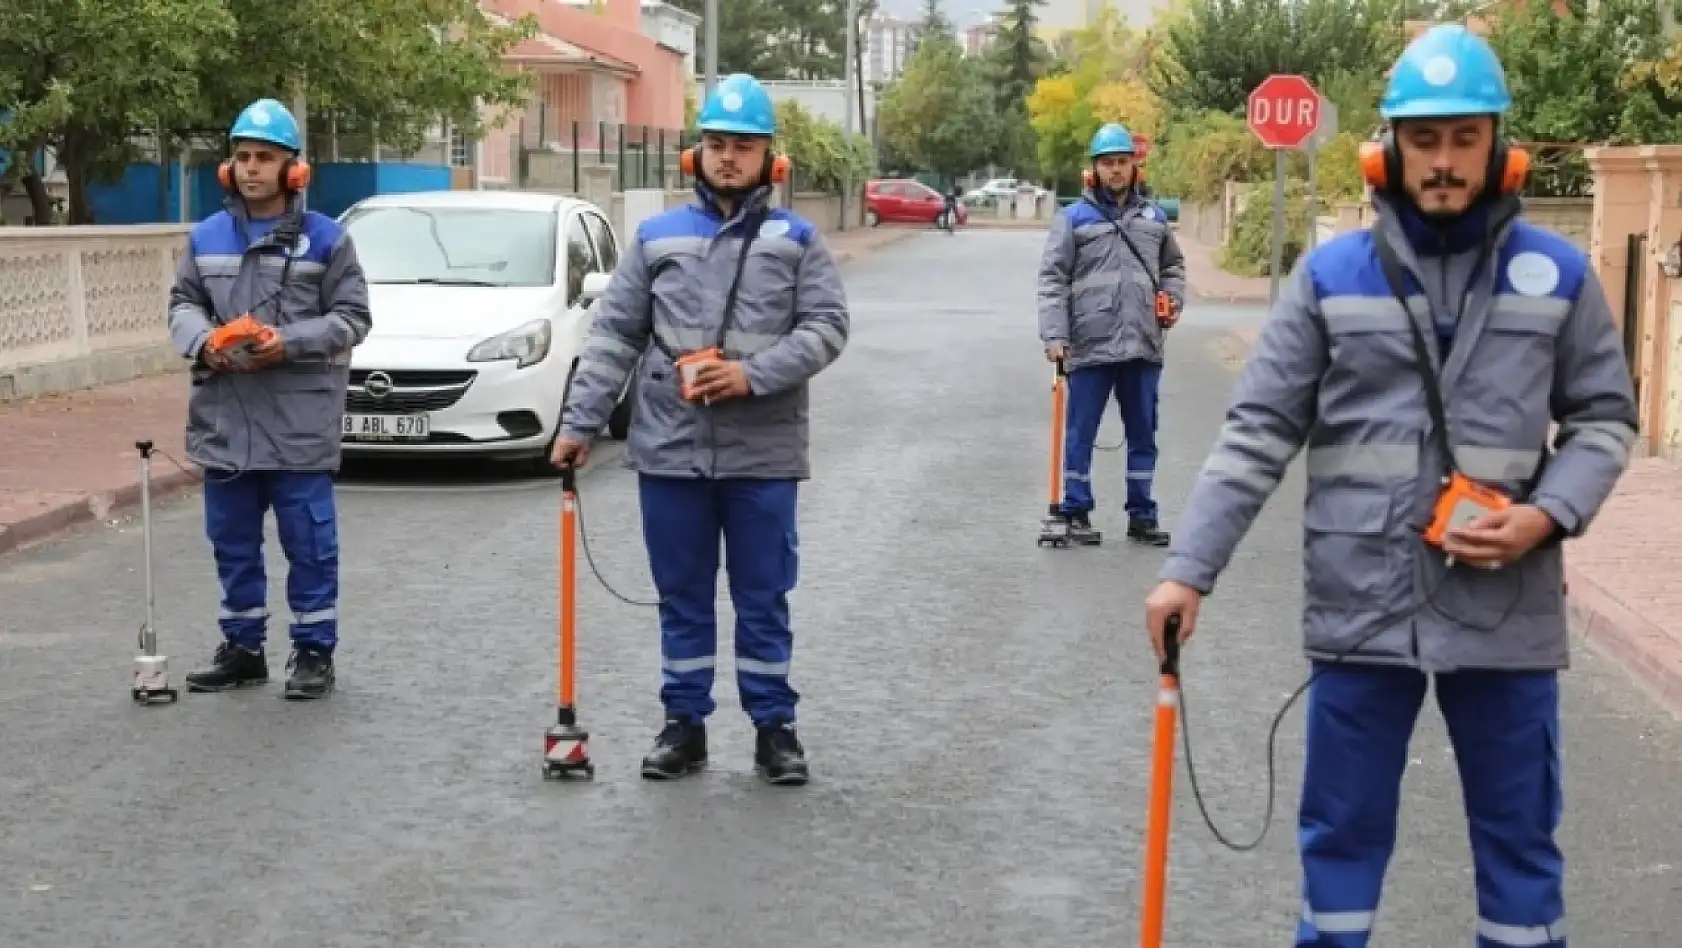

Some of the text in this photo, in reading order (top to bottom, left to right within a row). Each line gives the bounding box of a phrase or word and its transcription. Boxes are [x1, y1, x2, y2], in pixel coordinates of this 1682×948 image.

[1253, 98, 1314, 126] DUR
[362, 416, 389, 434] ABL
[397, 416, 424, 434] 670
